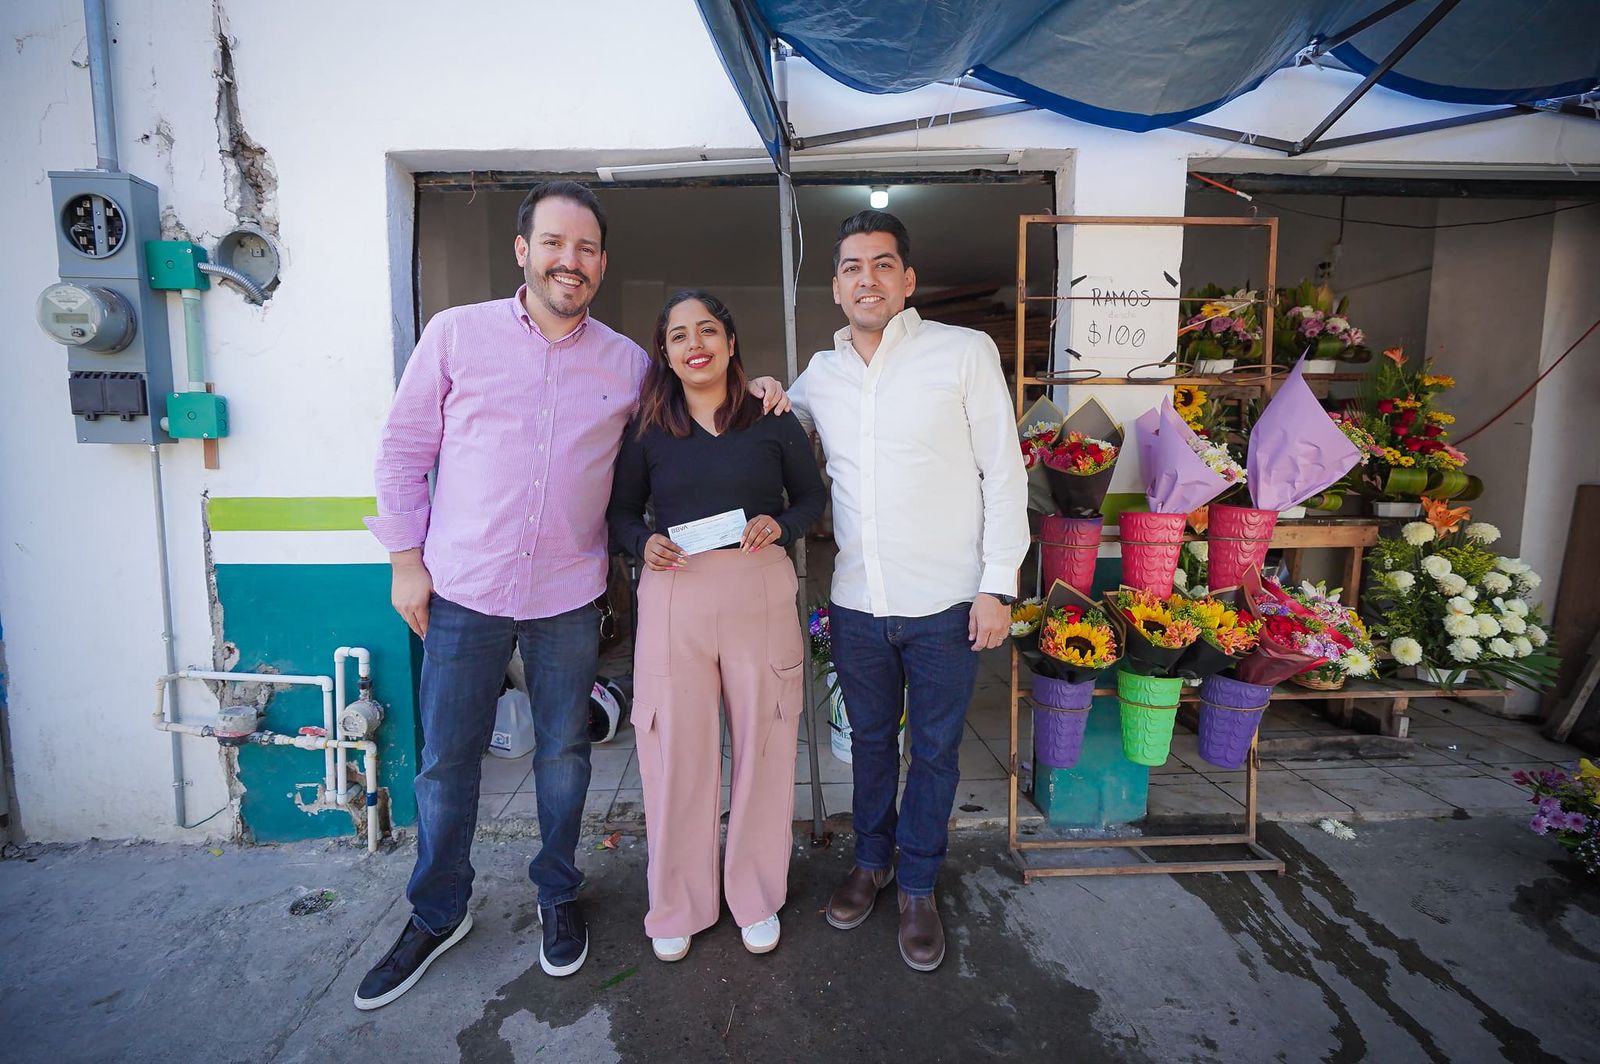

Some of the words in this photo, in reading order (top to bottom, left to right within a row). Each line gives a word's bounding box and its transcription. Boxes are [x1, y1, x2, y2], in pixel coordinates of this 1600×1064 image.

[1092, 287, 1151, 307] RAMOS
[1087, 320, 1146, 348] $100
[671, 525, 688, 534] BBVA
